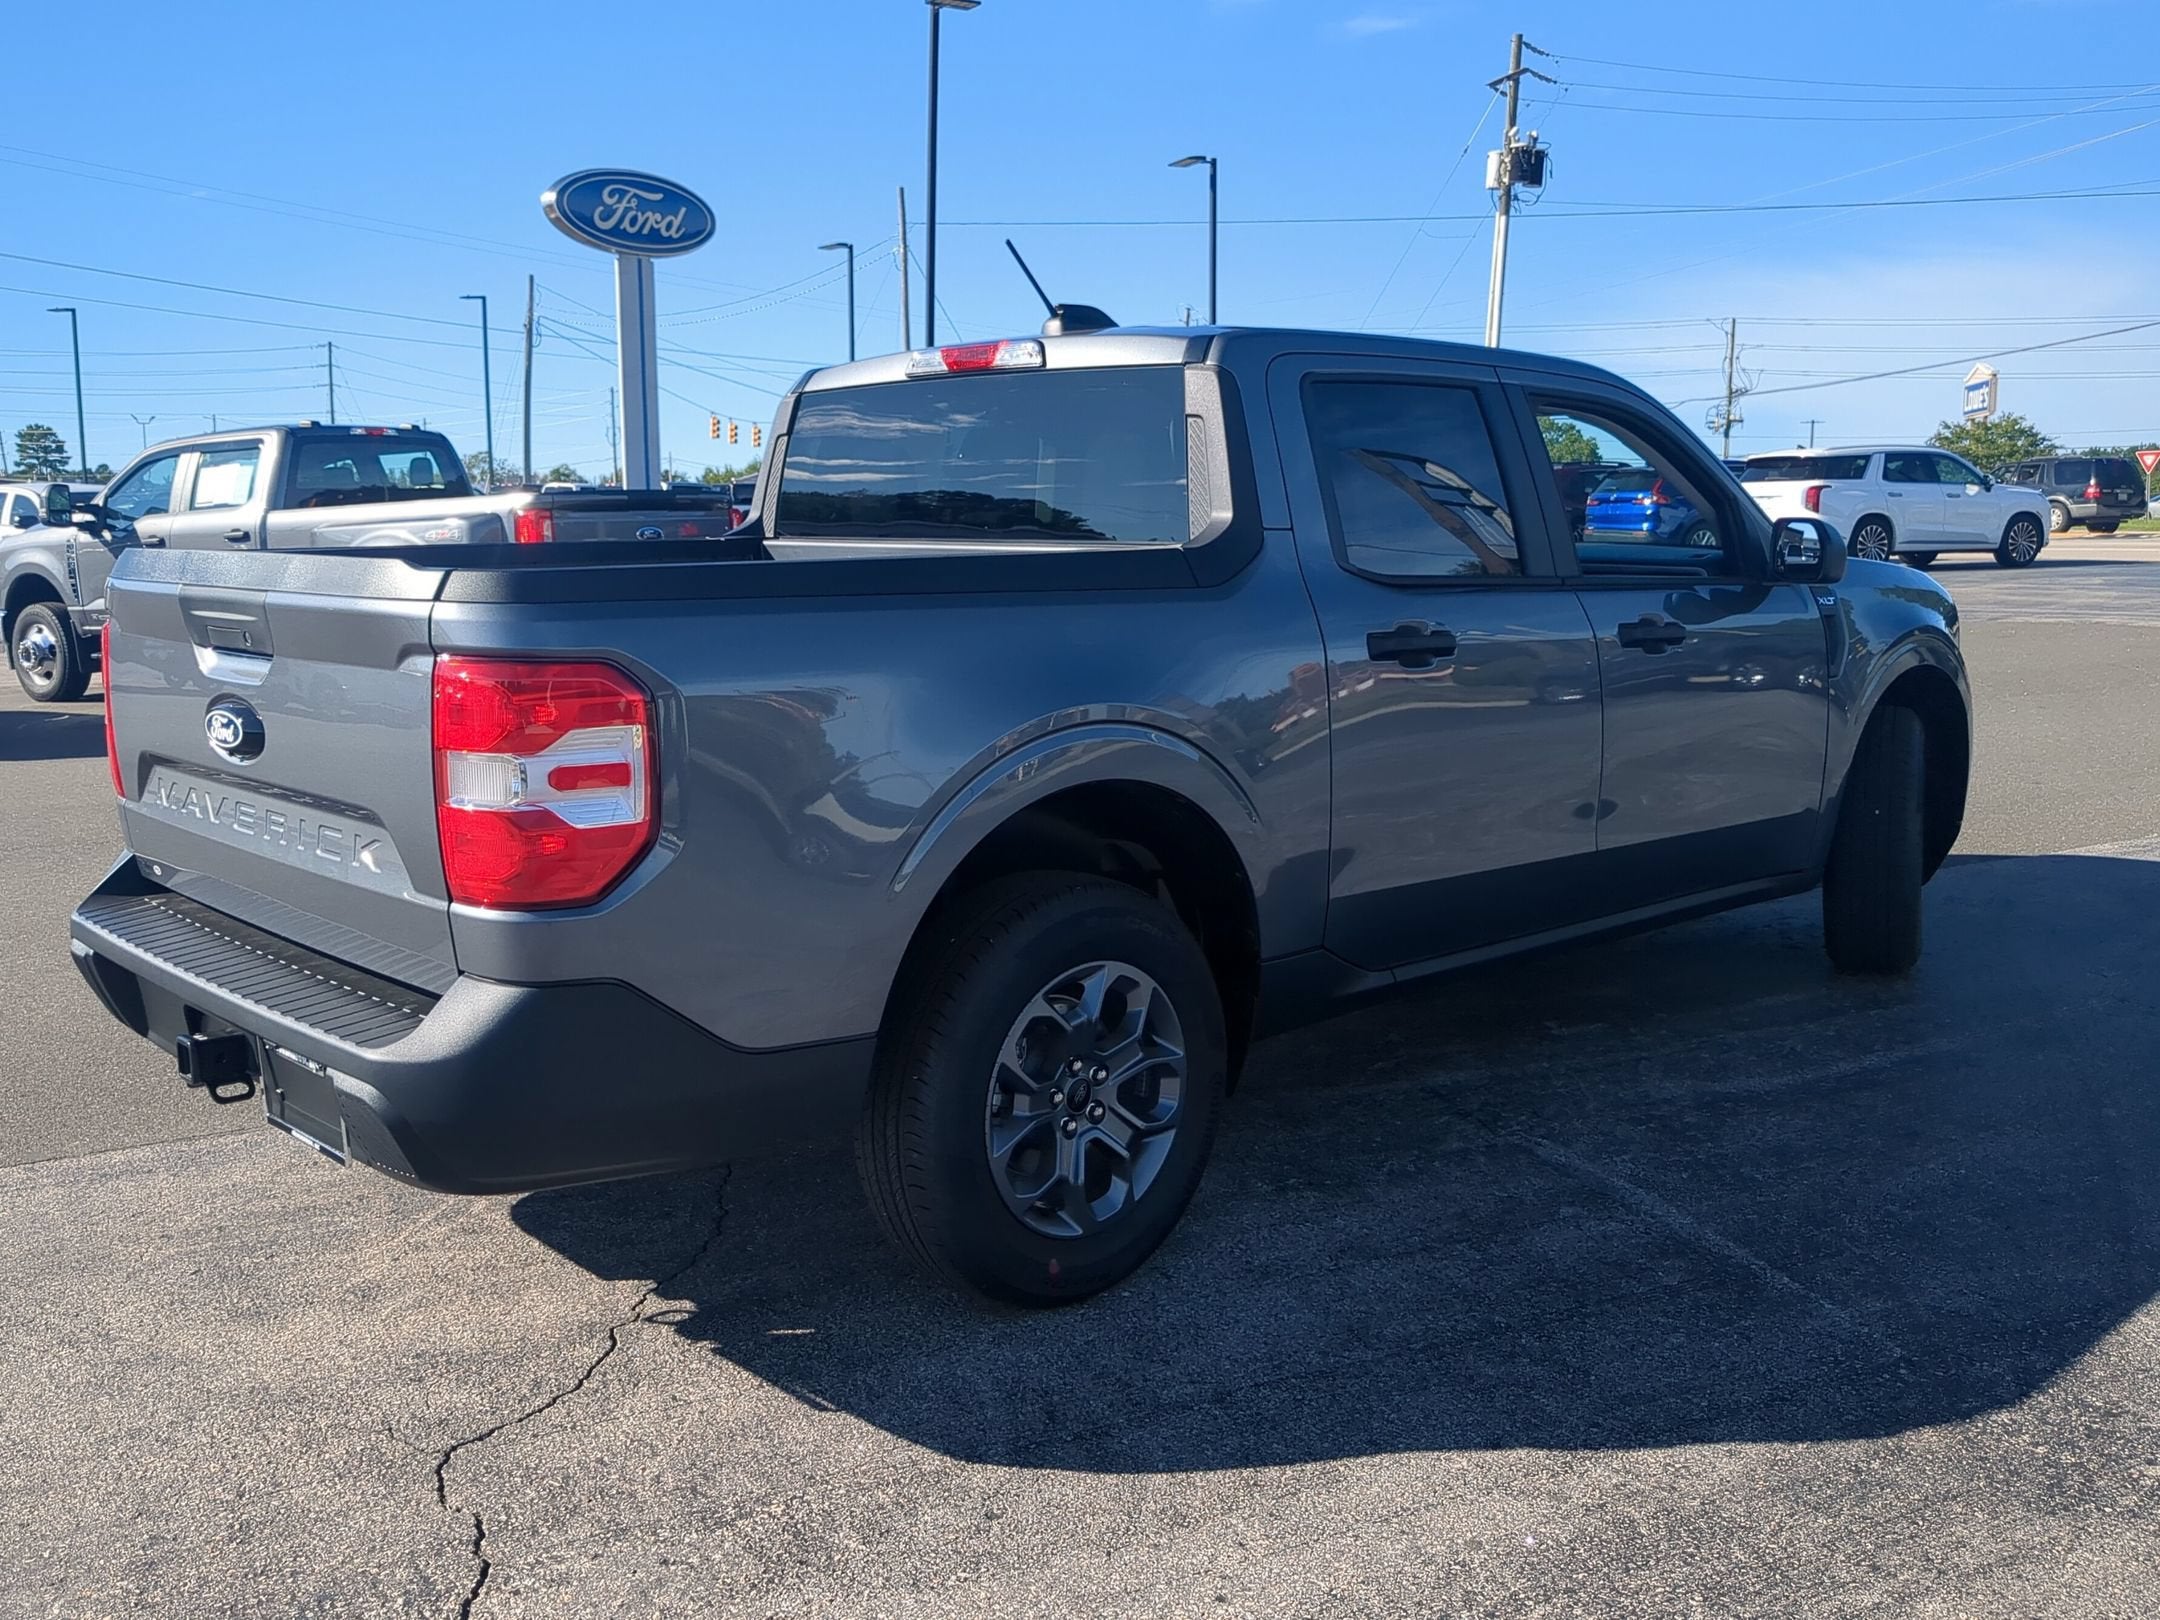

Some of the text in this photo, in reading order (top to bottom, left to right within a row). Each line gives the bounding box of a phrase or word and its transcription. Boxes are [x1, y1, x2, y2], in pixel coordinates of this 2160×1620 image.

[593, 184, 687, 238] Ford
[1964, 384, 1989, 411] LOWE'S
[1816, 596, 1836, 605] XLT
[210, 714, 235, 742] Ford
[156, 776, 383, 874] MAVERICK
